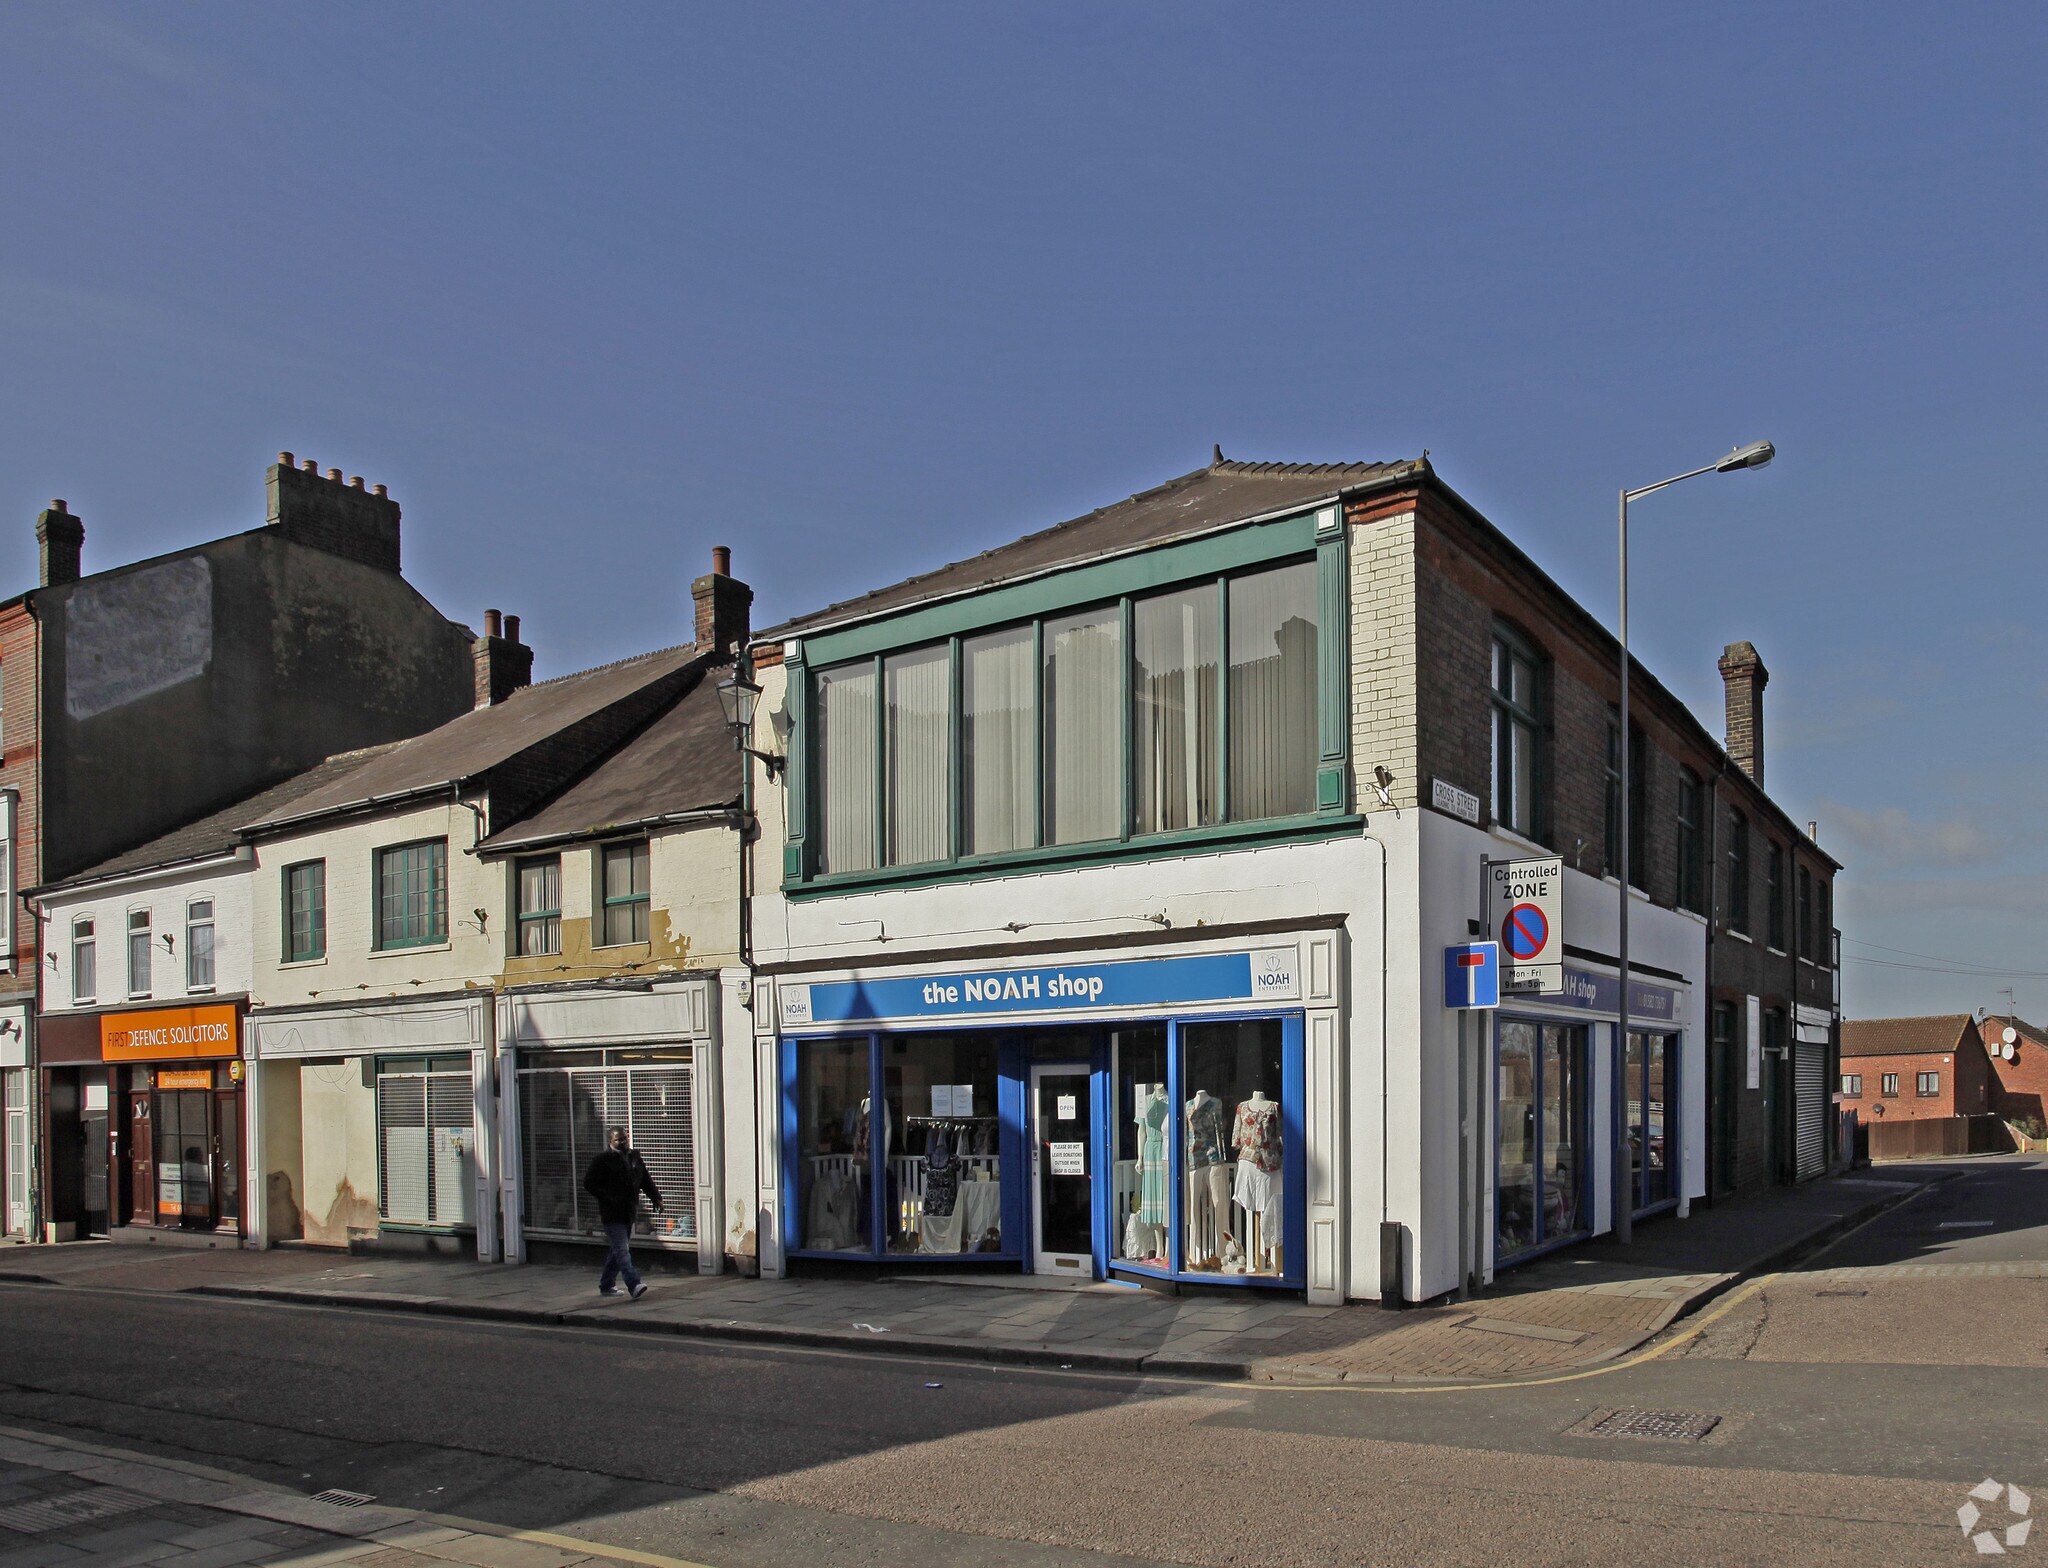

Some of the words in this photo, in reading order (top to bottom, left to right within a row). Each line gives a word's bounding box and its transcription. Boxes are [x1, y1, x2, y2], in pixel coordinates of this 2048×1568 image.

[1435, 783, 1454, 803] CROSS
[1457, 792, 1477, 812] STREET
[1495, 865, 1558, 881] Controlled
[1503, 882, 1548, 899] ZONE
[1258, 973, 1290, 986] NOAH
[1509, 970, 1525, 978] Mon
[1531, 969, 1542, 977] Fri
[922, 981, 958, 1004] the
[964, 975, 1041, 1002] NOAH
[1047, 973, 1104, 1002] shop
[1528, 980, 1546, 988] 5pm
[1578, 978, 1597, 1005] shop
[786, 1003, 807, 1014] NOAH
[170, 1023, 229, 1044] SOLICITORS
